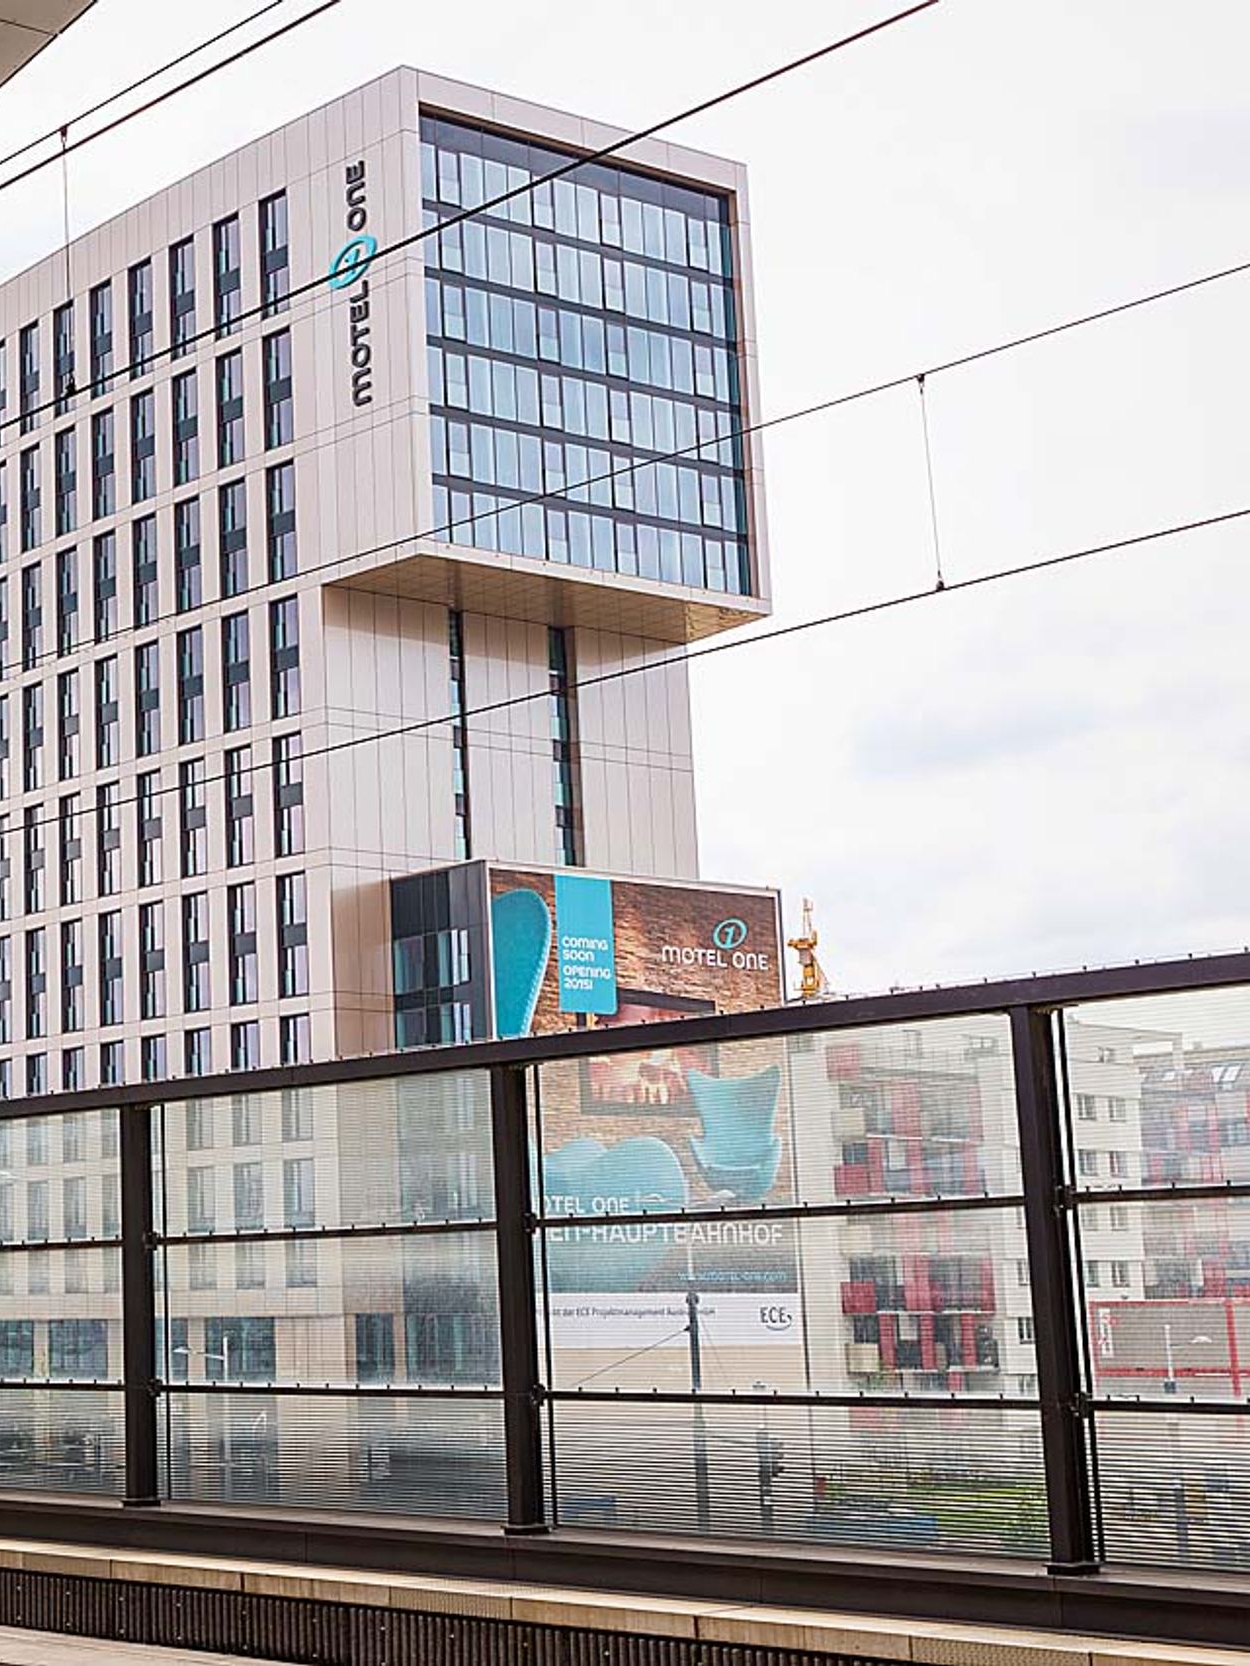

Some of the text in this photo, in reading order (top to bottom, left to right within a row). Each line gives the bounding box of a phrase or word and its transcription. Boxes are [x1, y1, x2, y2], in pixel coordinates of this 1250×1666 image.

[346, 160, 367, 231] ONE
[350, 280, 372, 407] MOTEL
[562, 936, 609, 951] COMING
[562, 949, 595, 962] SOON
[661, 945, 769, 971] MOTEL ONE
[563, 965, 611, 980] OPENING
[535, 1195, 630, 1214] OTEL ONE
[760, 1306, 787, 1323] ECE
